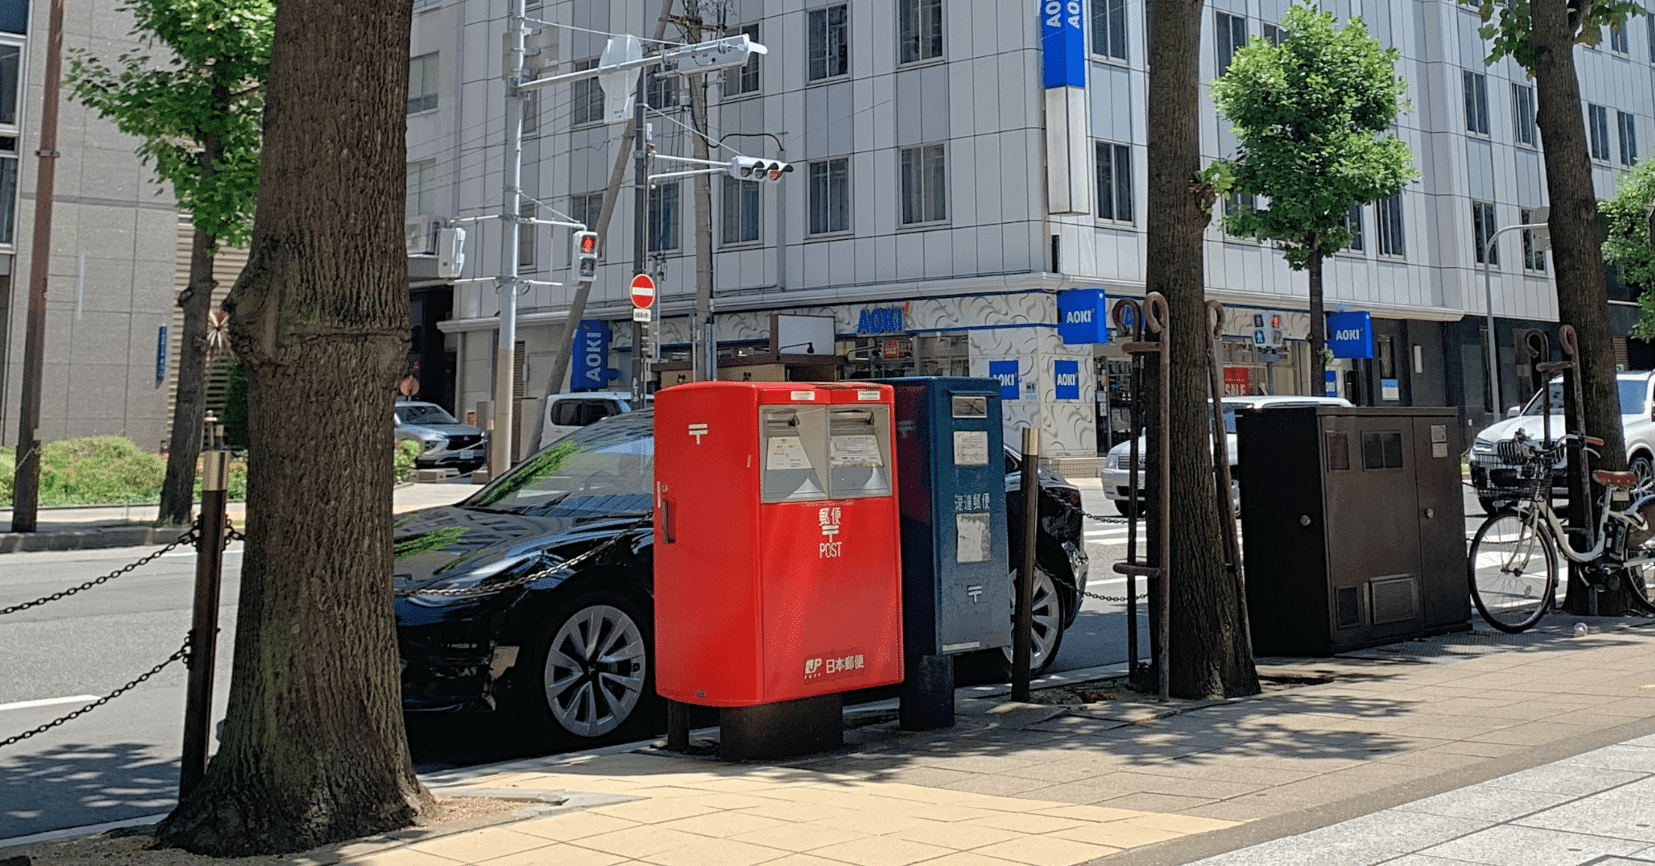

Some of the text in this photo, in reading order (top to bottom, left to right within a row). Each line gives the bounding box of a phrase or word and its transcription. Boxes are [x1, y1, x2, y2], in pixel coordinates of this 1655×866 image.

[1044, 0, 1062, 27] AO
[1067, 0, 1081, 29] AO
[857, 308, 903, 333] AOKI
[1066, 310, 1092, 323] AOKI
[1335, 329, 1360, 341] AOKI
[586, 332, 602, 382] AOKI
[1057, 373, 1076, 386] AOKI
[1224, 383, 1246, 396] SALE
[819, 507, 842, 526] 郵便
[820, 542, 842, 558] POST
[826, 654, 864, 673] 日本郵便
